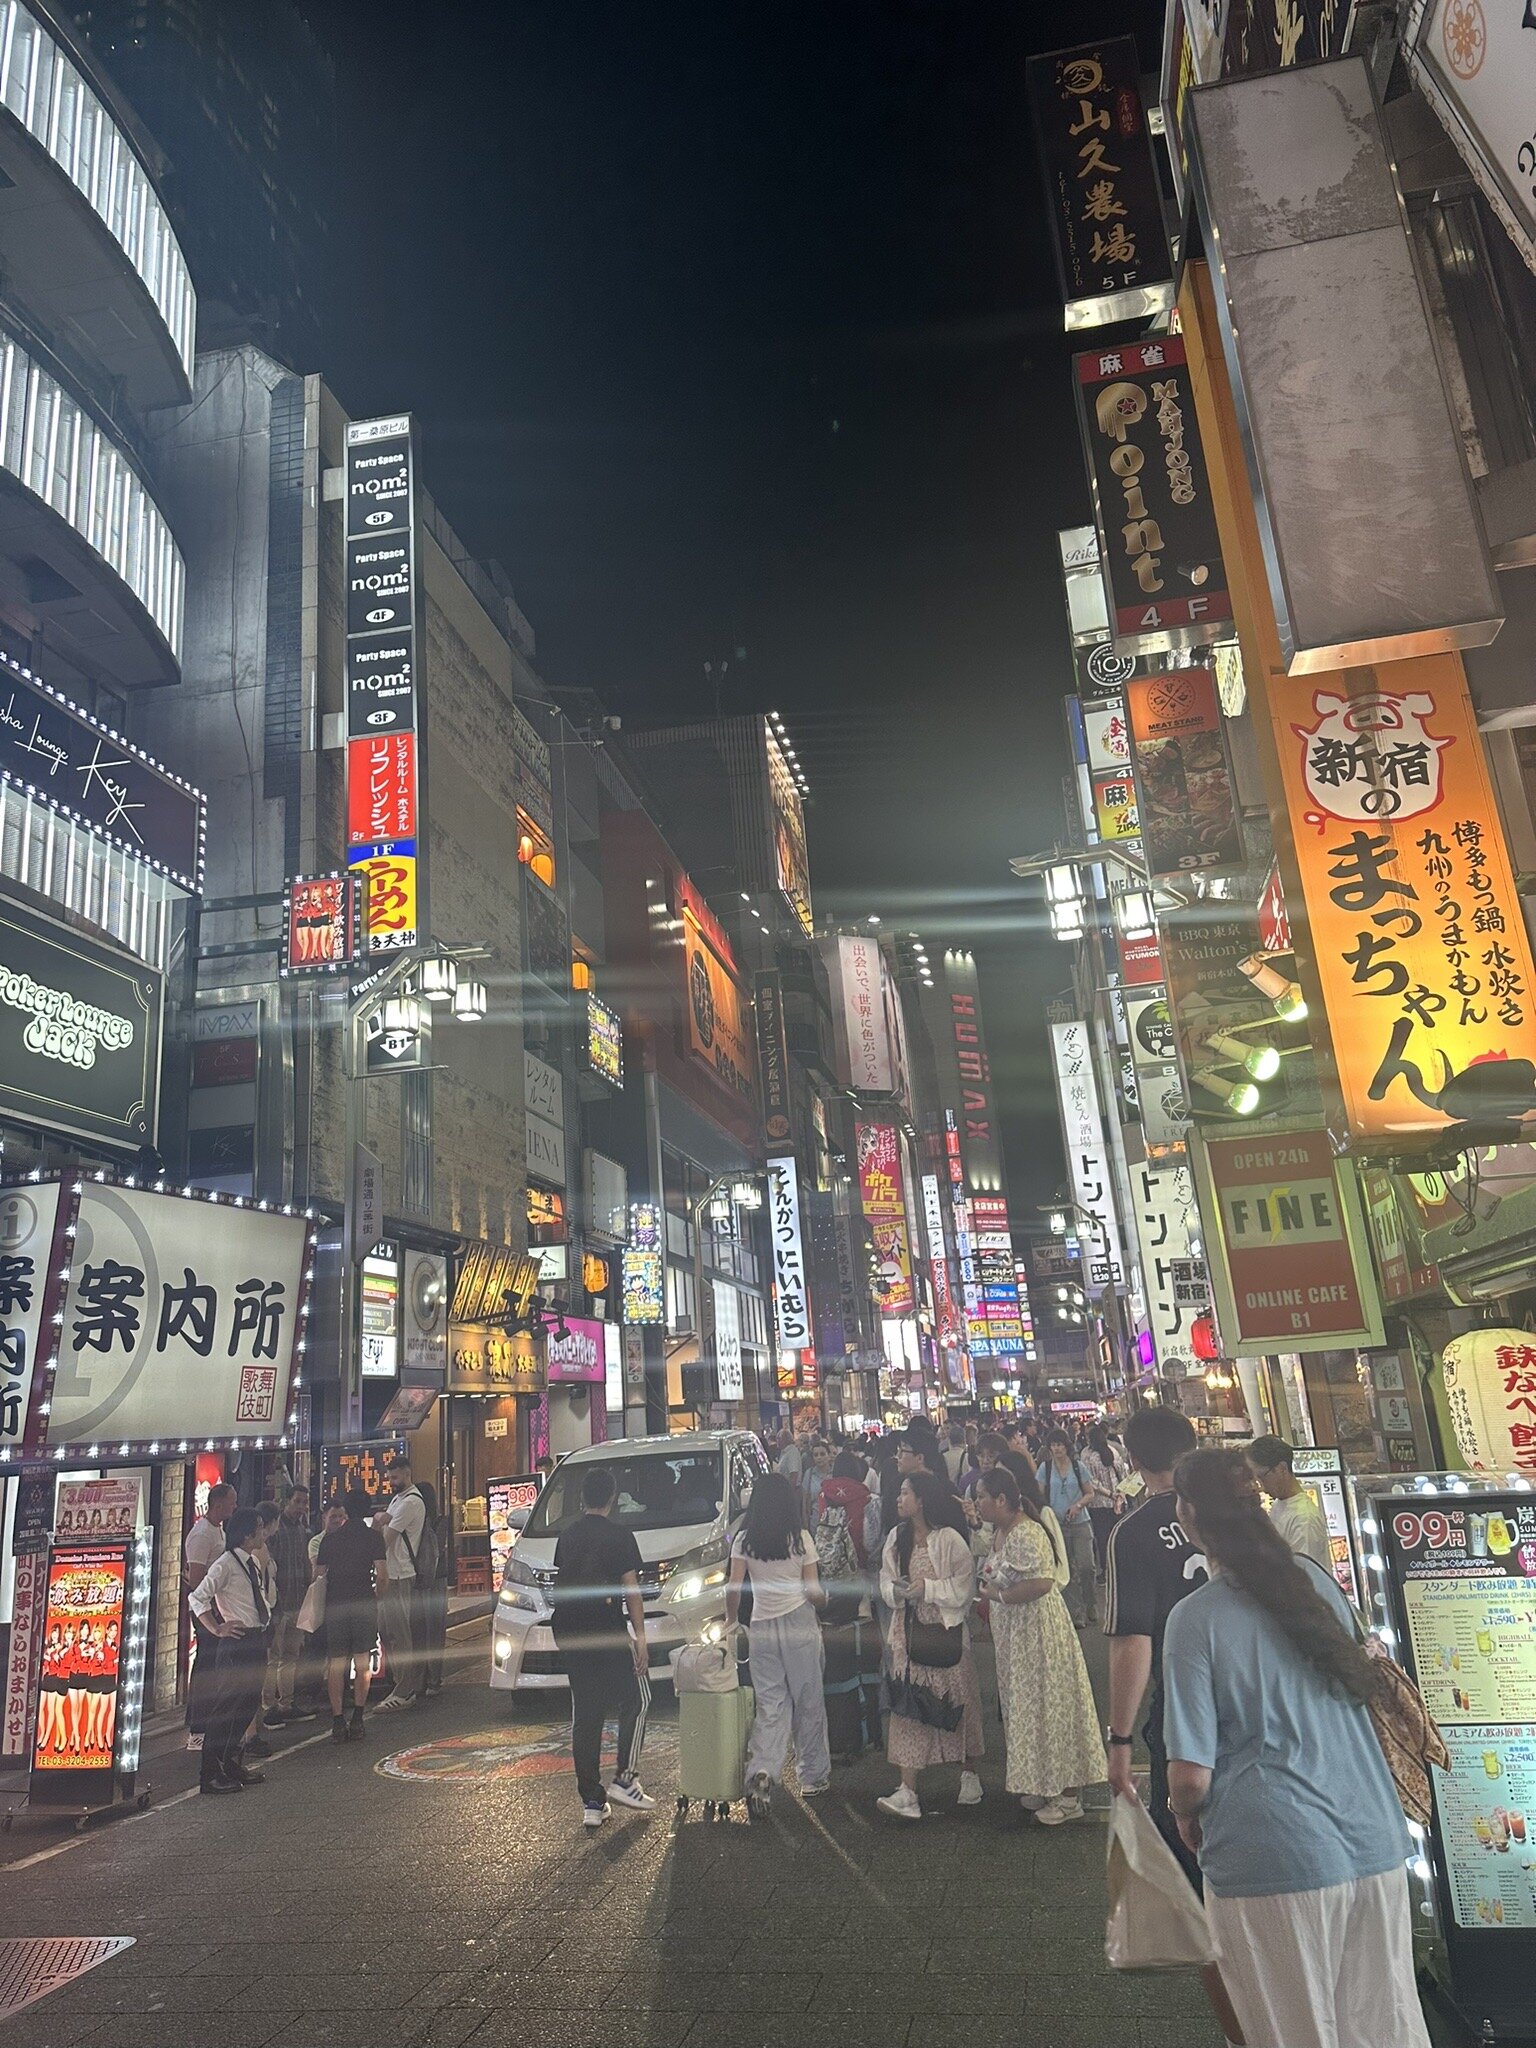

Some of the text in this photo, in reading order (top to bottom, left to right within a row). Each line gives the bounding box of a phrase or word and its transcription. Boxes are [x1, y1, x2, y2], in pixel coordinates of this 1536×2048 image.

[1069, 100, 1136, 266] 山久農場
[1099, 345, 1165, 376] 麻雀
[355, 453, 404, 469] Party Space
[356, 548, 405, 564] Party Space
[356, 648, 407, 663] Party Space
[397, 737, 408, 794] レンタルルーム
[1308, 733, 1432, 789] 新宿
[76, 739, 146, 845] Key
[370, 739, 391, 839] リフレッシュ
[1359, 787, 1402, 816] の
[372, 843, 395, 857] 1F
[1178, 852, 1220, 869] 3F
[1416, 828, 1488, 1027] 九州のうまかもん
[1451, 820, 1526, 1026] 博多もつ鍋 水炊き
[1327, 831, 1448, 1111] まっちゃん
[853, 944, 879, 1084] 出会いで、世界に色がついた
[23, 1014, 97, 1070] Jack
[388, 1038, 405, 1050] B1
[1146, 1030, 1163, 1038] The
[526, 1059, 557, 1094] レンタル
[528, 1128, 560, 1168] IENA
[1230, 1192, 1333, 1235] FINE
[777, 1249, 805, 1338] にいむら
[1176, 1283, 1211, 1301] 新宿
[1246, 1285, 1348, 1310] ONLINE CAFE
[72, 1258, 286, 1360] 案内所
[1290, 1312, 1311, 1329] B1
[969, 1338, 1025, 1351] SPA SAUNA
[508, 1485, 538, 1506] 980
[1323, 1483, 1337, 1493] 5F
[53, 1585, 119, 1607] 飲み放題
